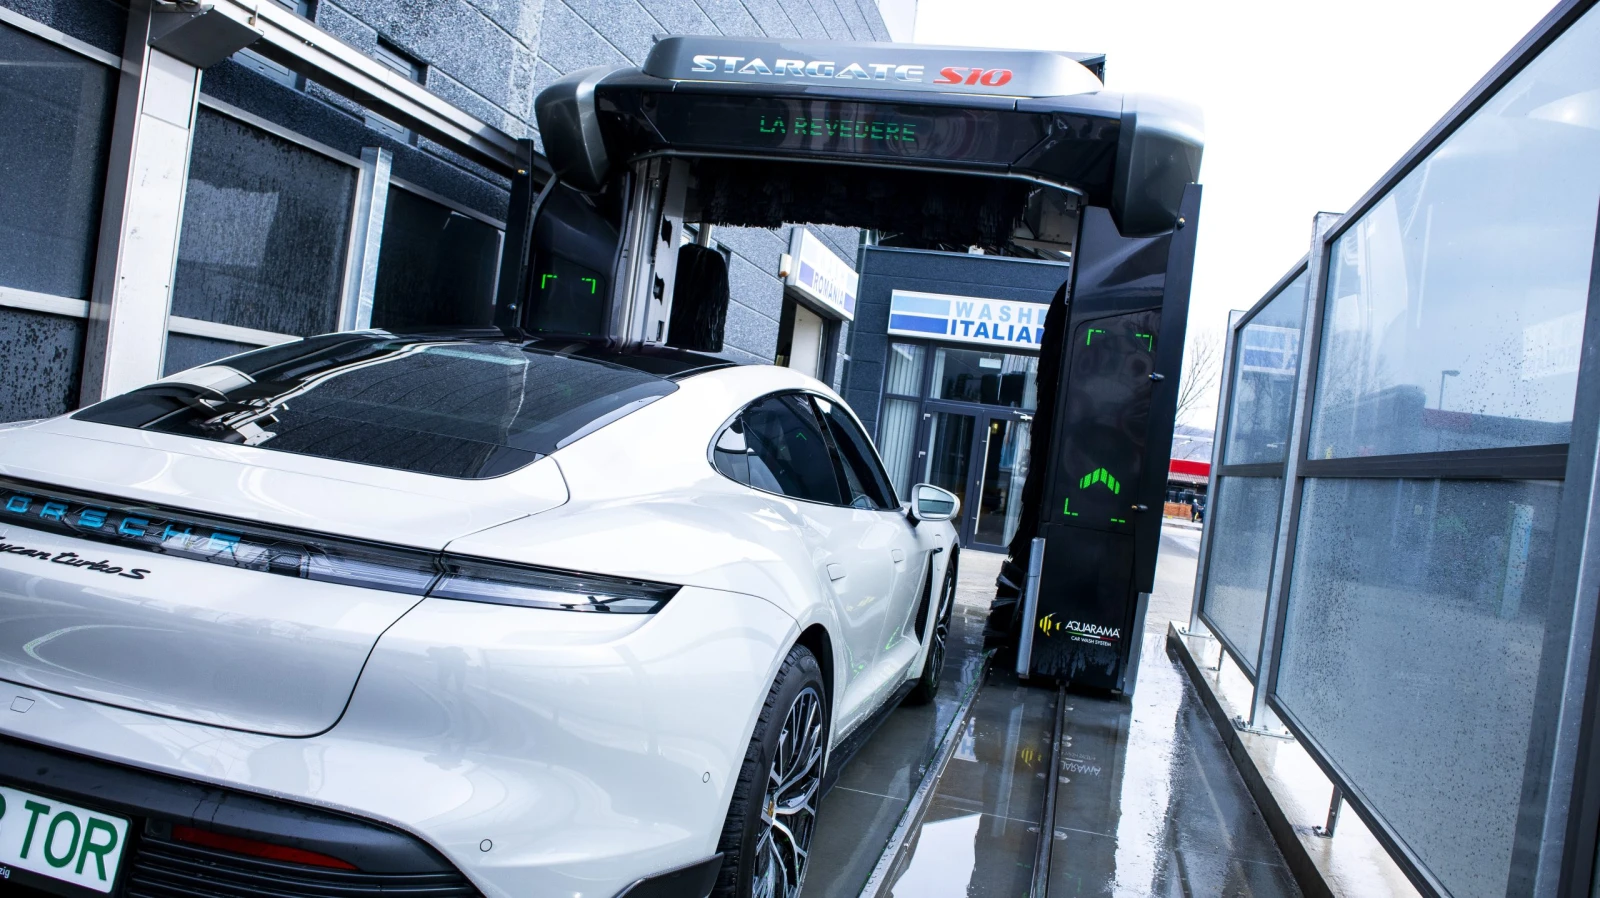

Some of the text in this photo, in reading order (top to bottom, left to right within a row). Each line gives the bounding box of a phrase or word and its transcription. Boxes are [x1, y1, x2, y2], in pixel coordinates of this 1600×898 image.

[691, 55, 1013, 87] STARGATE S10
[760, 115, 916, 142] LA REVEDERE
[955, 300, 1032, 325] WASH
[950, 319, 1032, 344] ITALIA
[5, 495, 242, 551] ORSCHE
[51, 552, 123, 574] turbo
[118, 568, 151, 580] S
[1065, 620, 1120, 638] AQUARAMA
[1081, 637, 1094, 645] WASH
[20, 799, 118, 881] TOR
